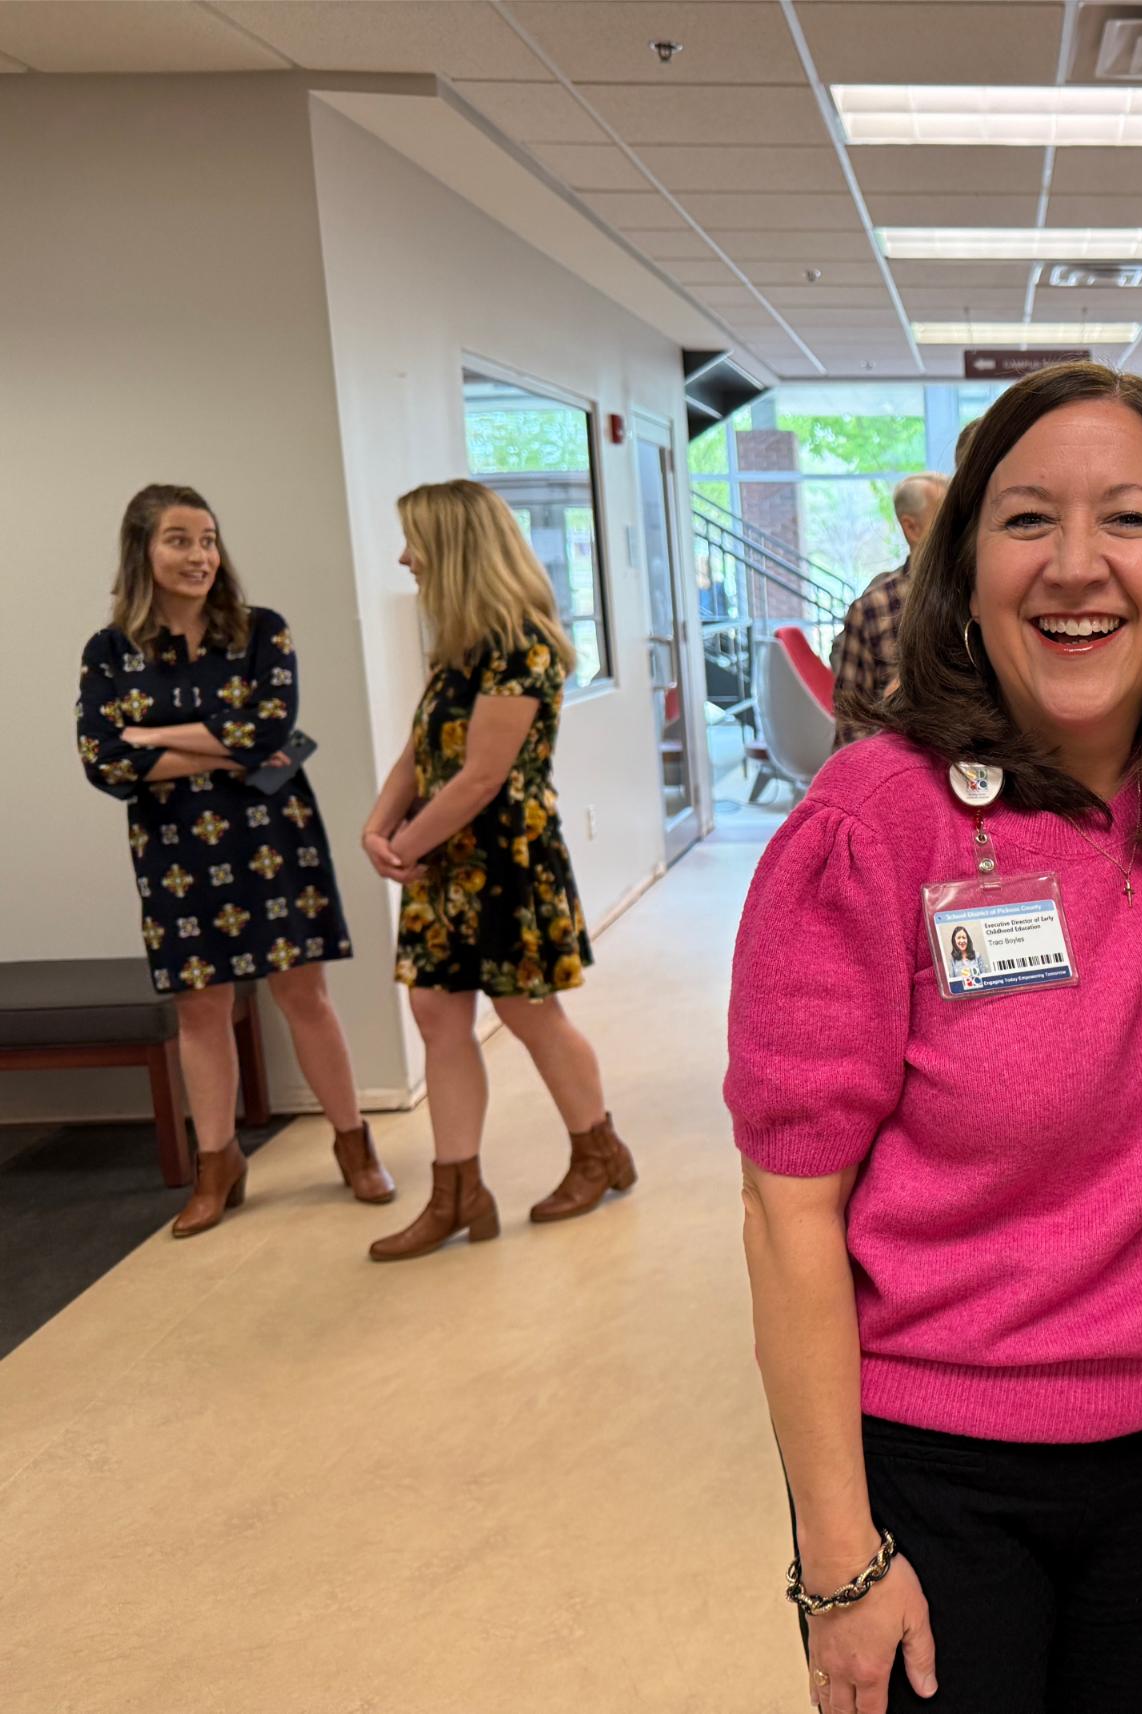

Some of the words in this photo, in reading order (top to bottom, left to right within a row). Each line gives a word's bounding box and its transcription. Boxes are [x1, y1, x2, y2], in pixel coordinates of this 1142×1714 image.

[984, 921, 1010, 929] Executive
[1011, 918, 1032, 926] Director
[985, 927, 1014, 935] Childhood
[1014, 924, 1041, 932] Education
